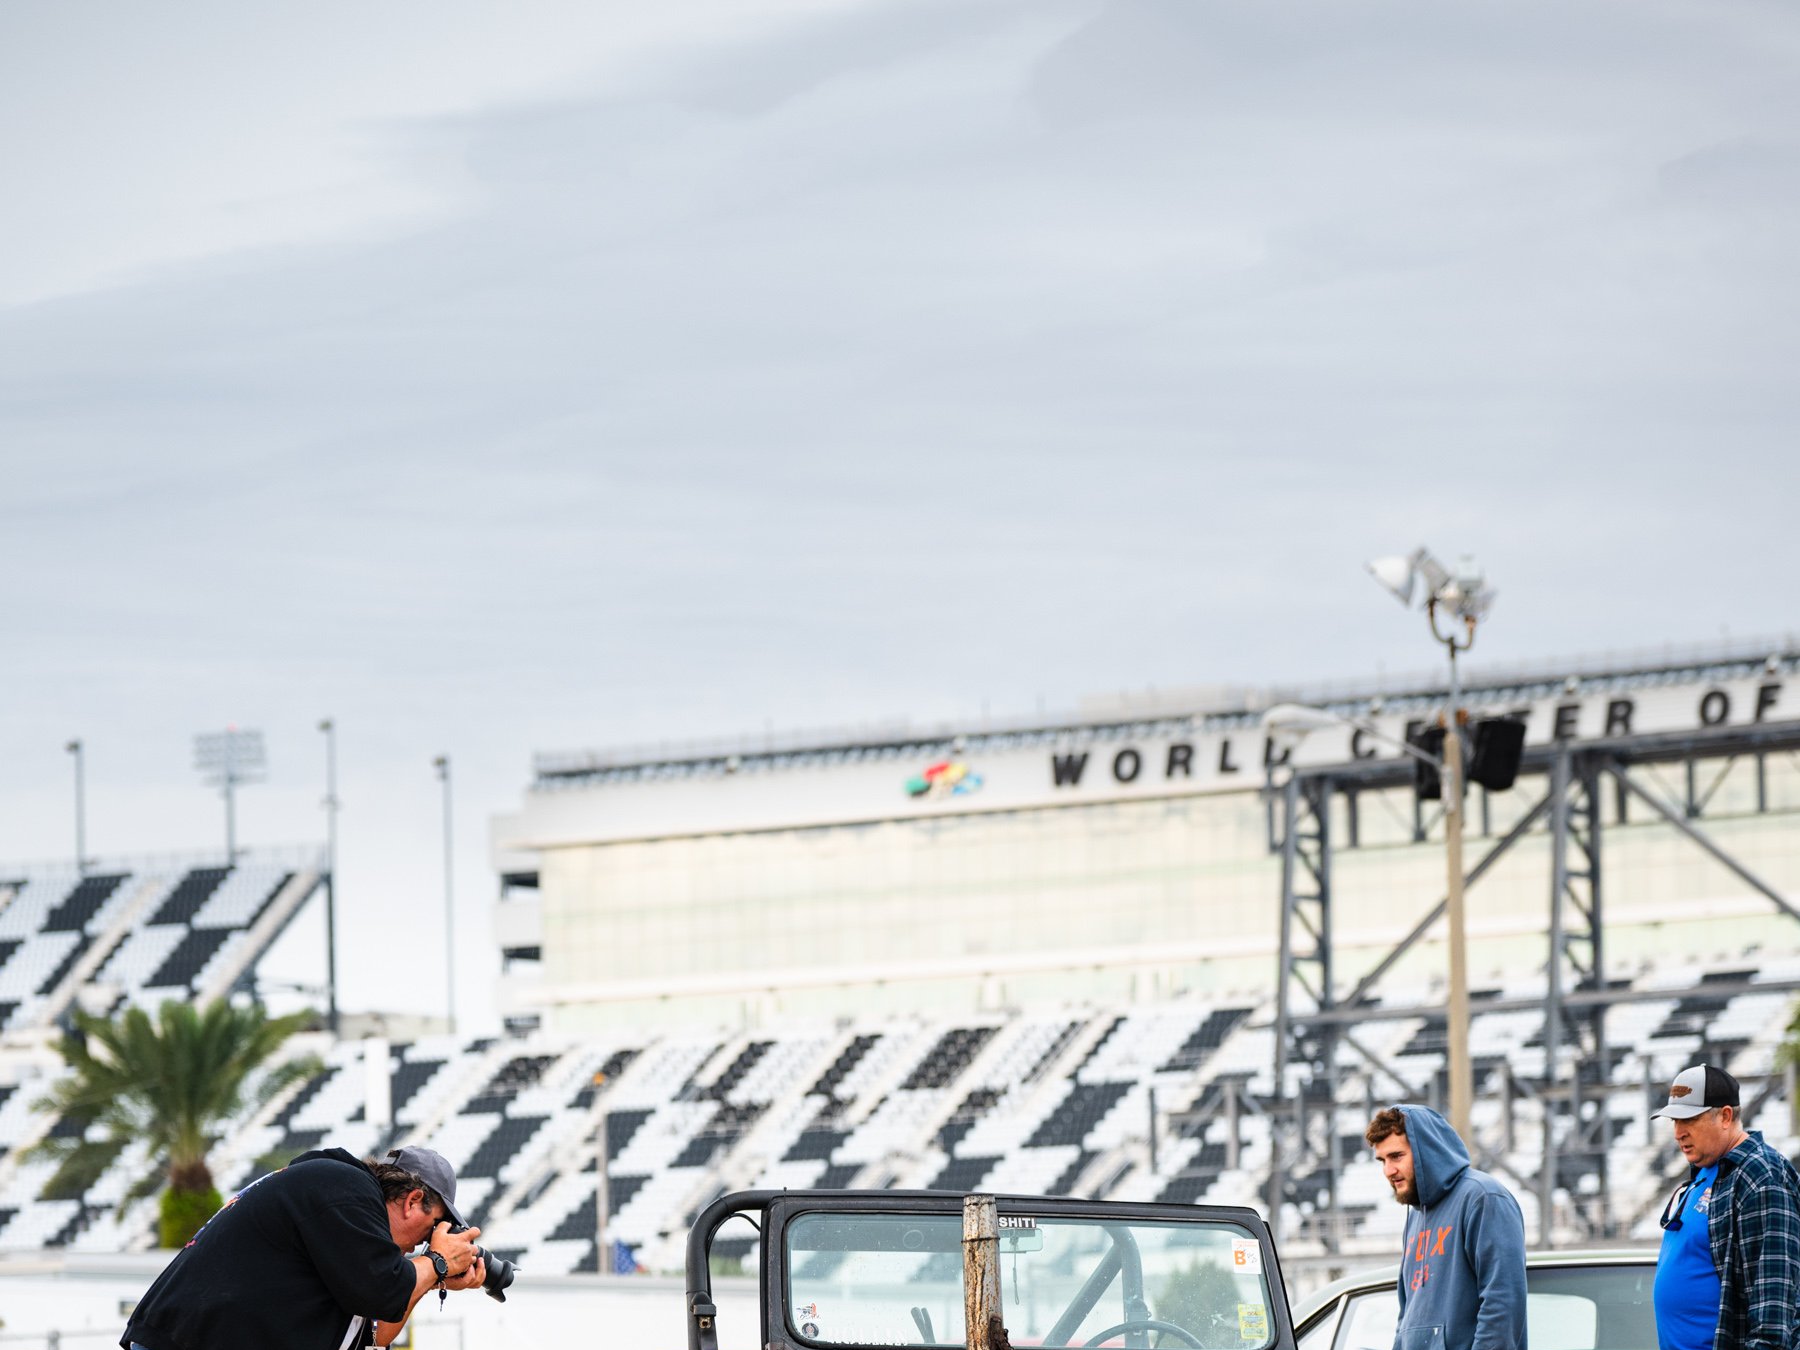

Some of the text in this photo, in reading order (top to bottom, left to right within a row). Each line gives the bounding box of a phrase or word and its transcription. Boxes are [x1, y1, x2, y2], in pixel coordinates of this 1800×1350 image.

[1052, 683, 1782, 787] WORLD CER OF
[998, 1216, 1036, 1228] SHITI
[1234, 1250, 1247, 1265] B
